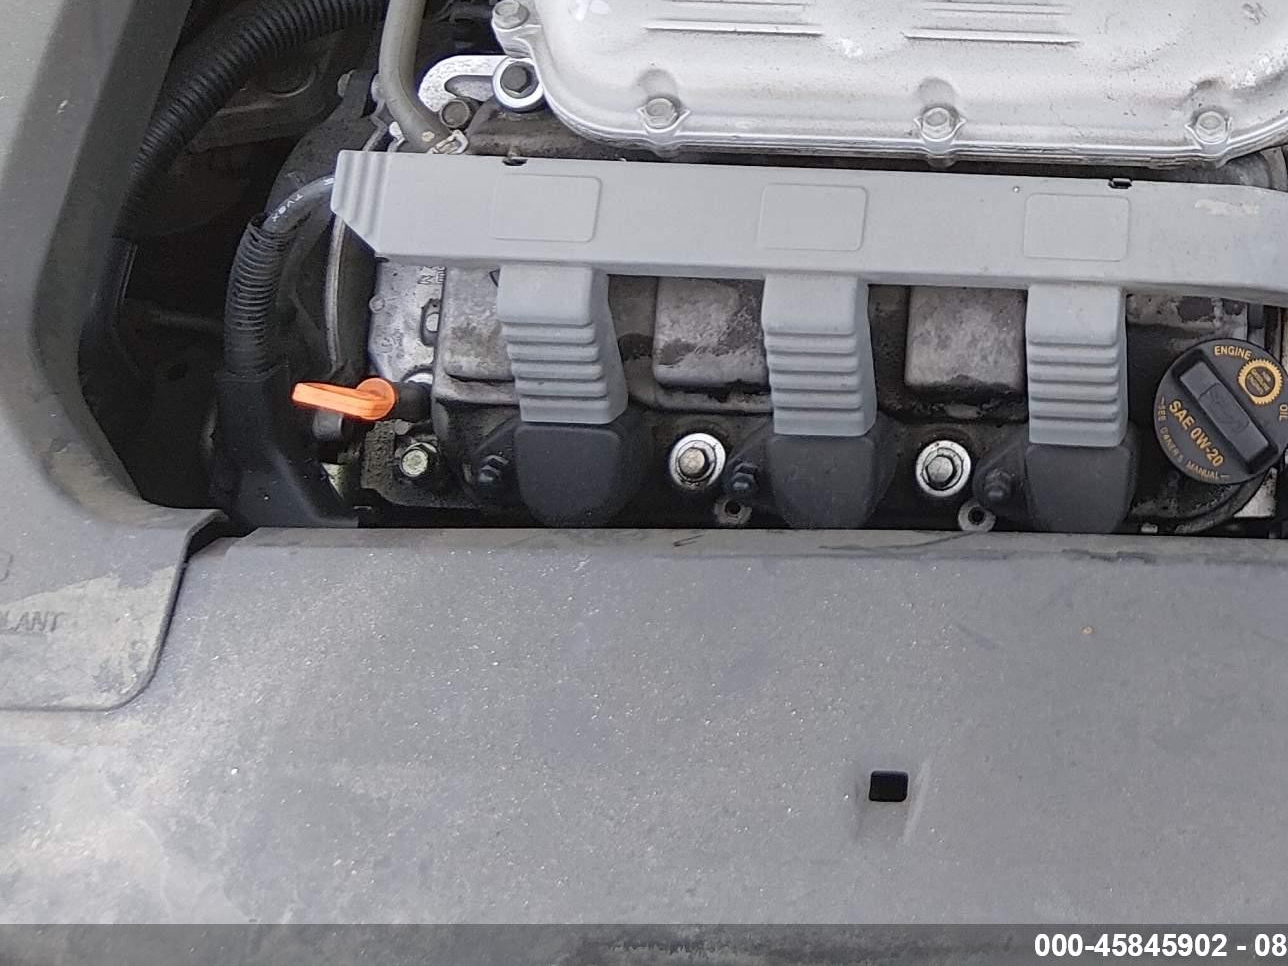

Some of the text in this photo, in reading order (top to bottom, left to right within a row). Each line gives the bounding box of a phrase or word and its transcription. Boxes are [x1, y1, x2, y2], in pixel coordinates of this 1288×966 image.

[1214, 345, 1288, 421] ENGINE OIL
[1168, 400, 1224, 467] SAE 0W-20
[0, 611, 65, 633] LANT
